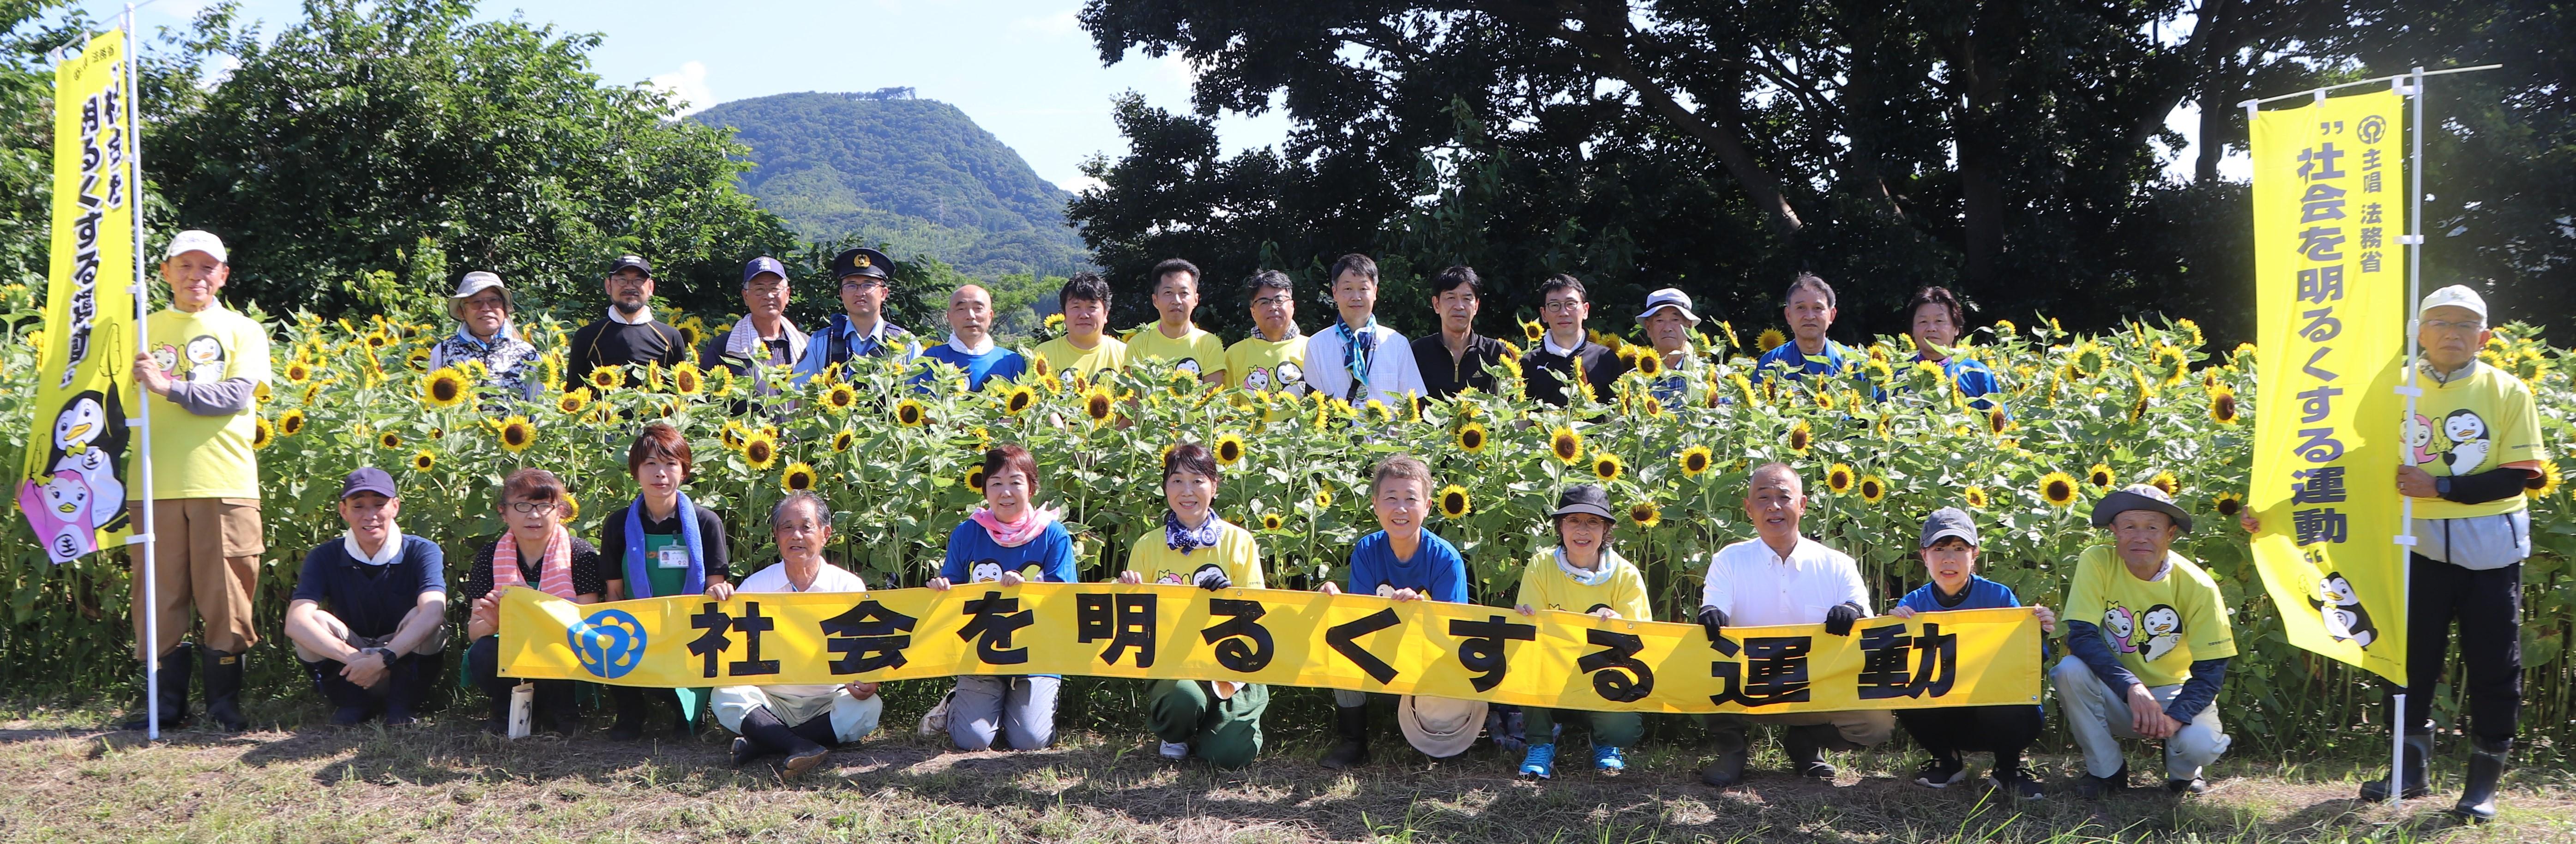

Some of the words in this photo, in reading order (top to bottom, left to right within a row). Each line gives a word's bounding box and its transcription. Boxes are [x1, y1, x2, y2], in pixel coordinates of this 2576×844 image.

[2362, 148, 2382, 194] 主唱
[2359, 202, 2383, 273] 法務省
[687, 591, 1957, 707] 社会を明るくする運動
